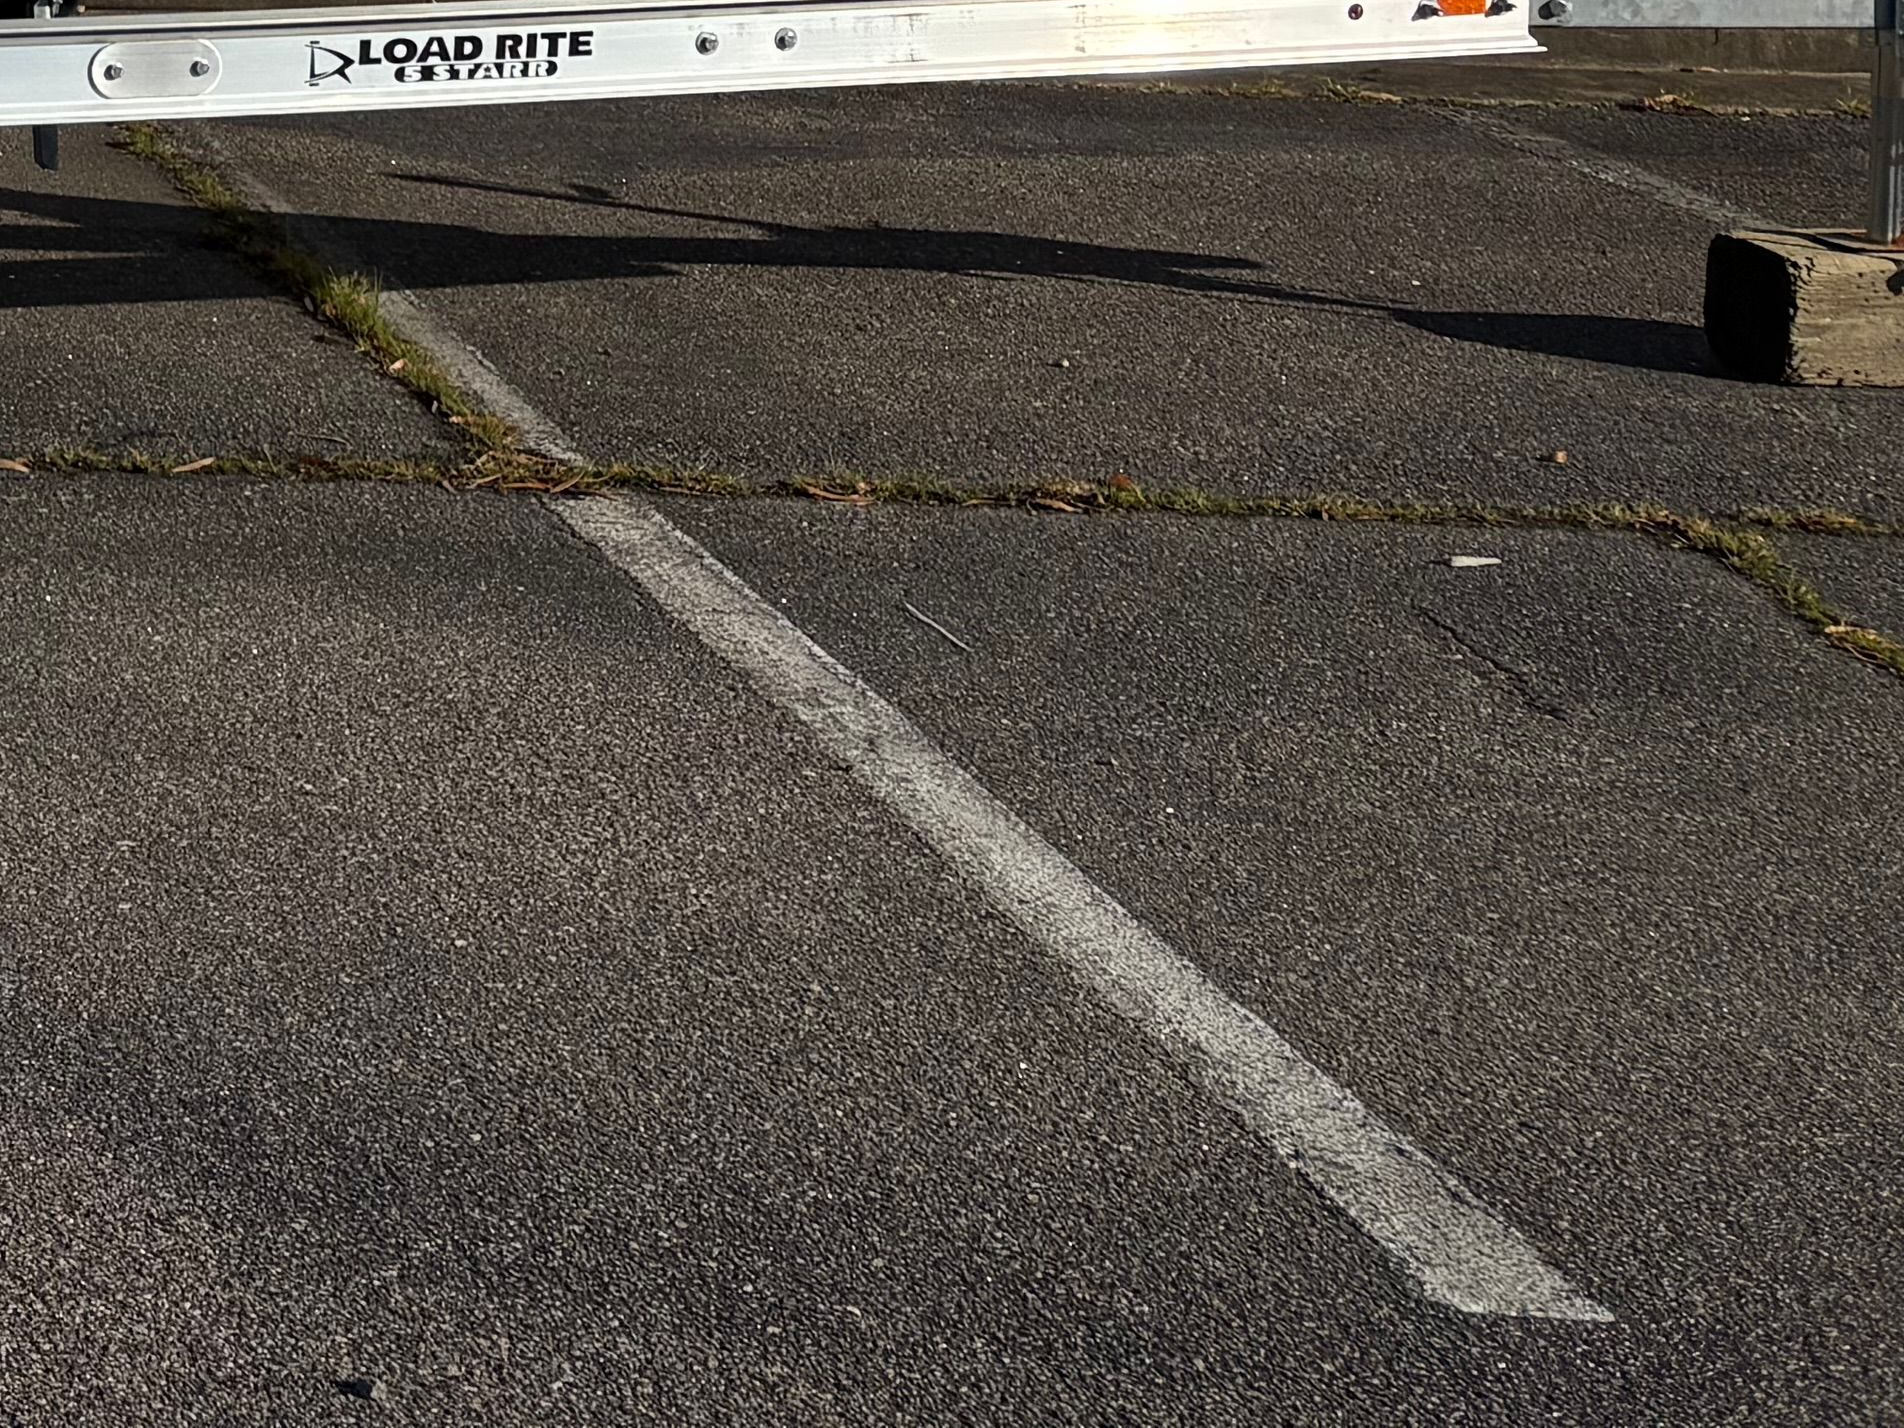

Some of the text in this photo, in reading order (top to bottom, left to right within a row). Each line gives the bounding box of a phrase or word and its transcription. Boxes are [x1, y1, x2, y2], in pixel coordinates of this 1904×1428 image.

[358, 31, 594, 65] LOAD RITE
[403, 61, 550, 82] 5 STARR
